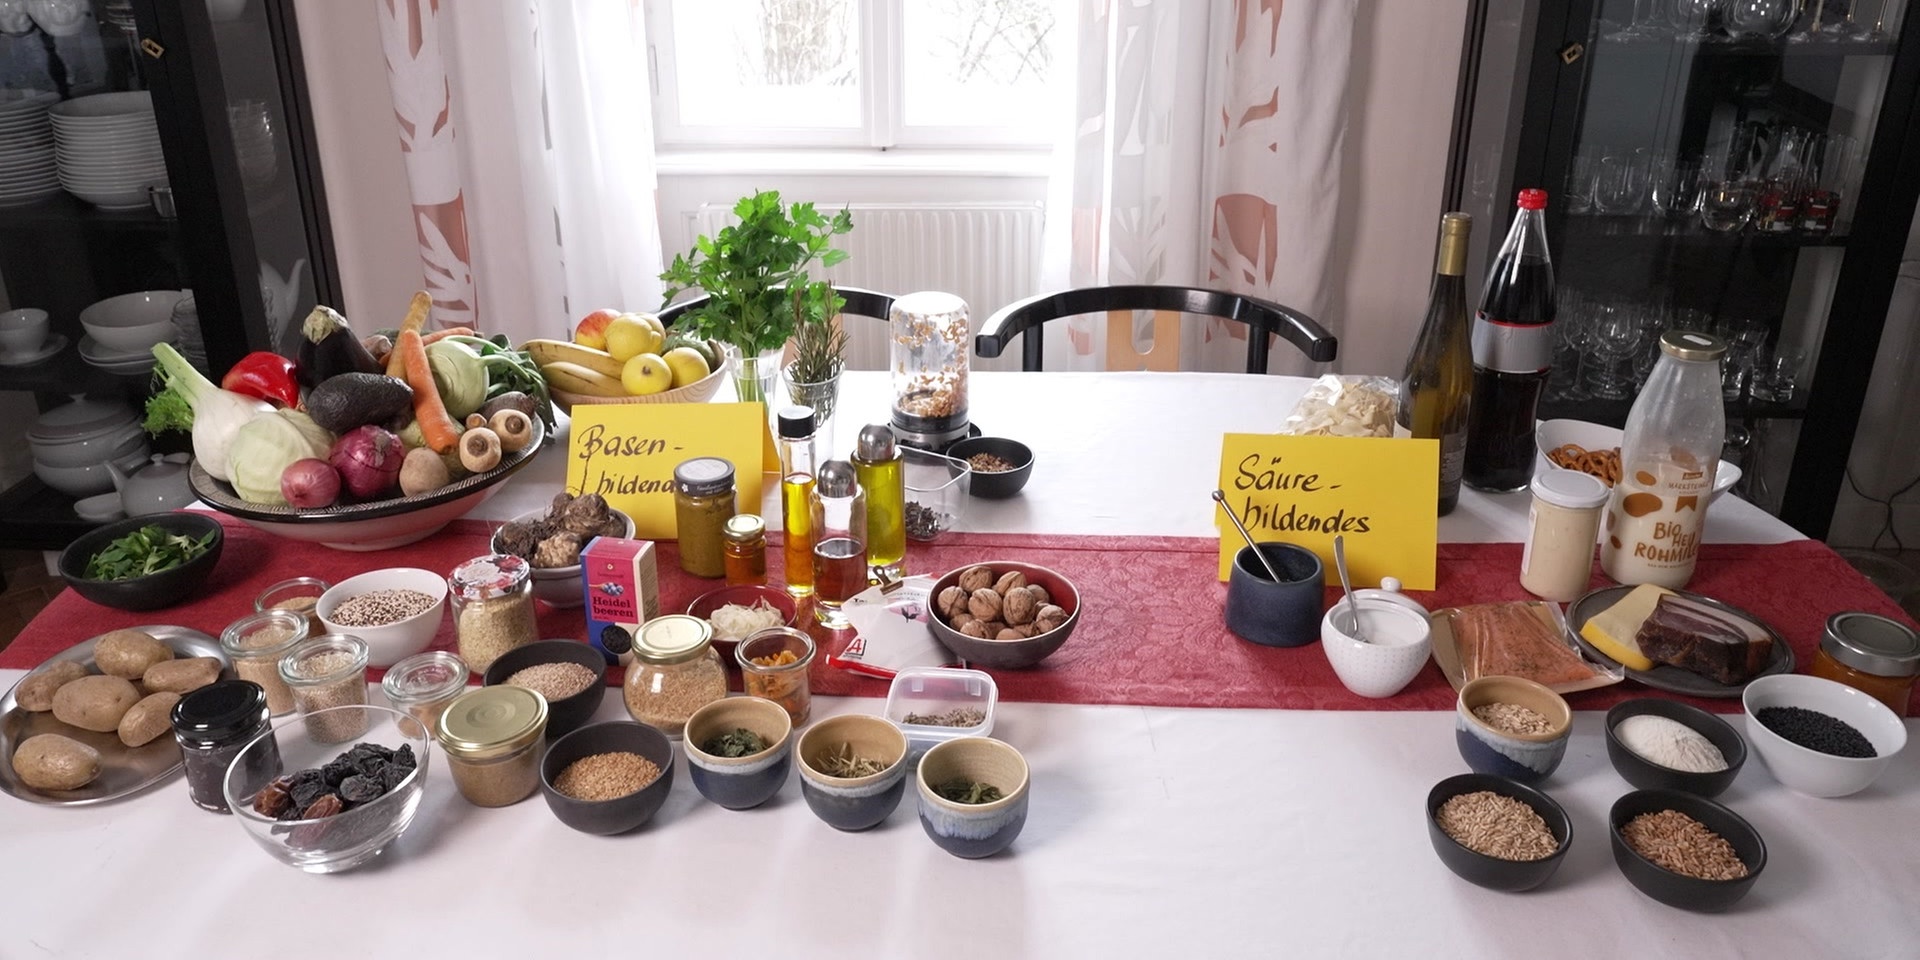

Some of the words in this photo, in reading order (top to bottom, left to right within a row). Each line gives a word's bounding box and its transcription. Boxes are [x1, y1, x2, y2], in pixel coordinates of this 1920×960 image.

[595, 470, 676, 496] bildend
[1243, 496, 1370, 534] bildendes
[592, 596, 631, 608] Heidel
[593, 606, 634, 618] beeren
